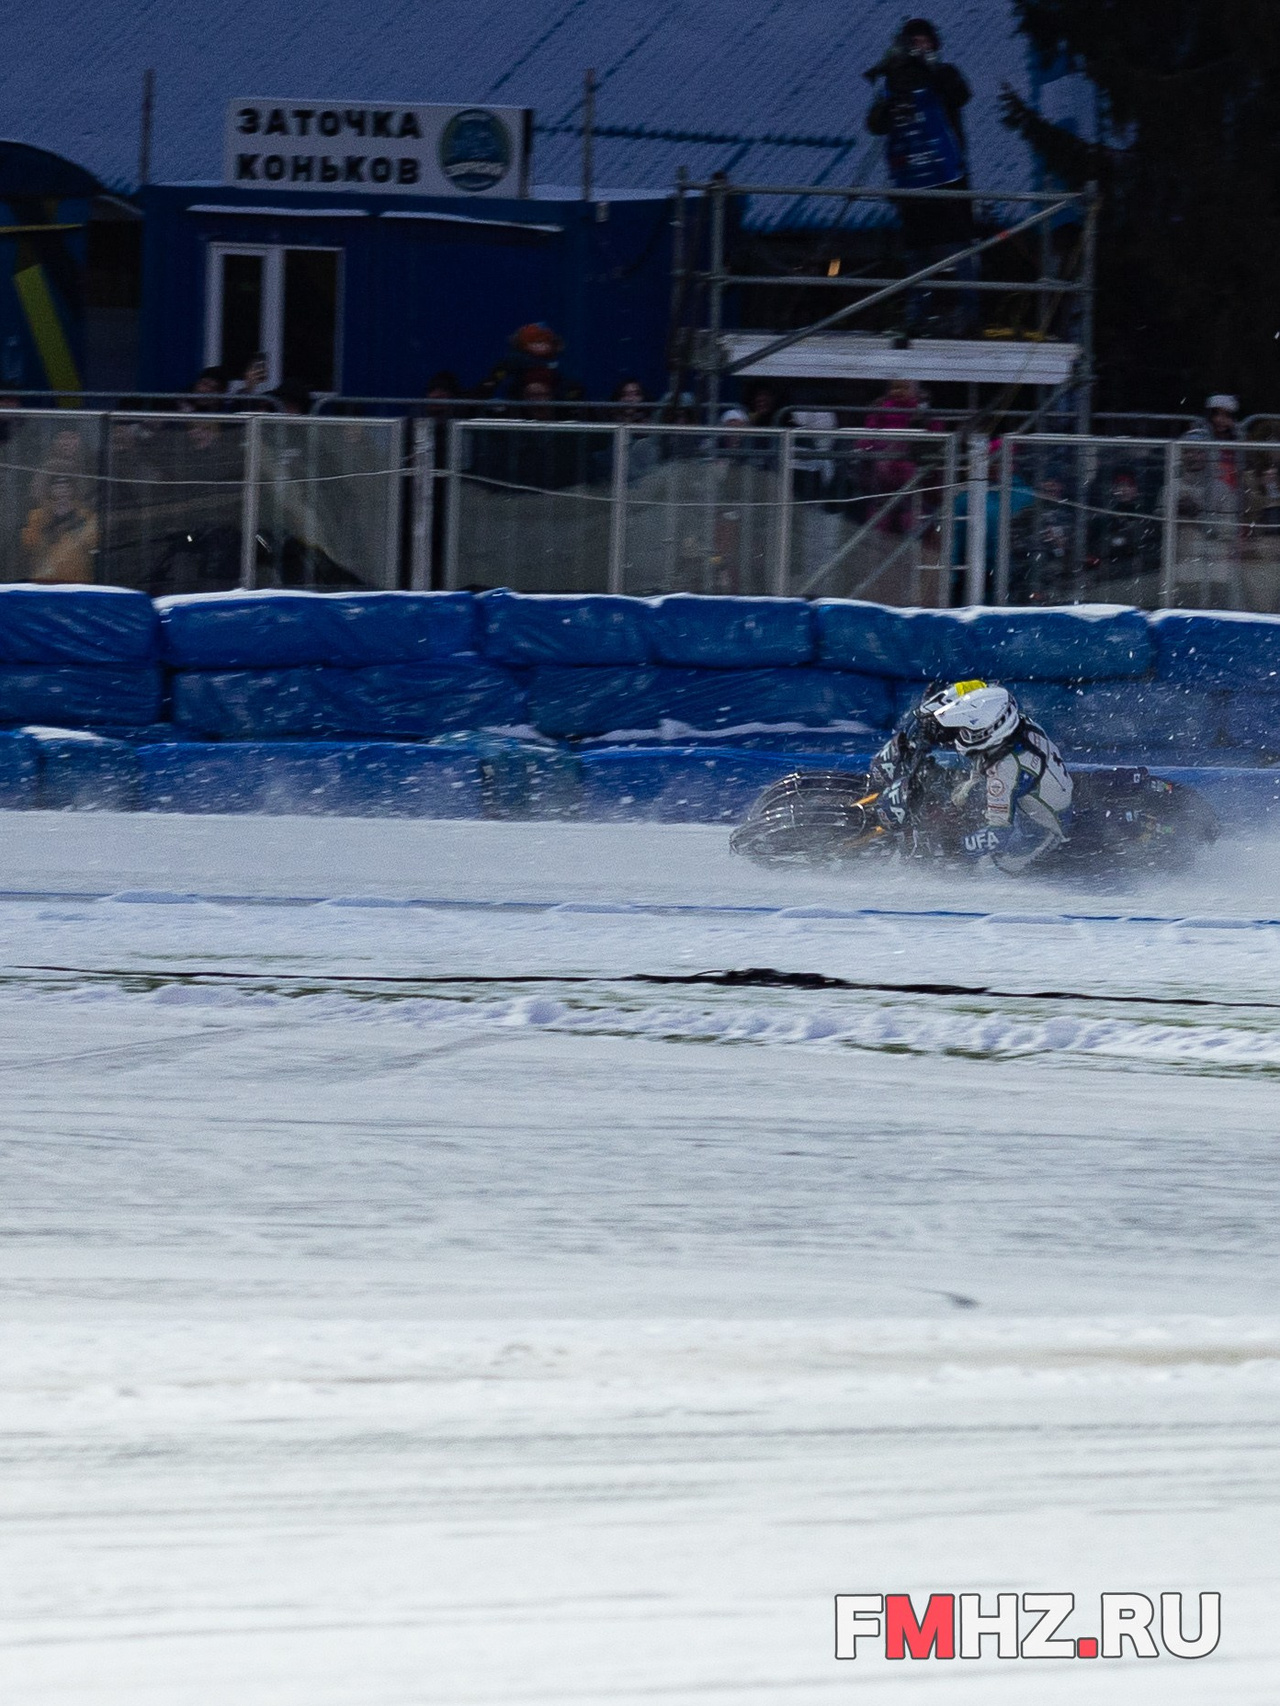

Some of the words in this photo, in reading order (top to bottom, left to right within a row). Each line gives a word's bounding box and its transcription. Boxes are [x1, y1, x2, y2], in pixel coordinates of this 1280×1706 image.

[237, 108, 422, 139] ЗАТОЧКА
[236, 153, 420, 184] КОНЬКОВ
[964, 830, 999, 851] UFA
